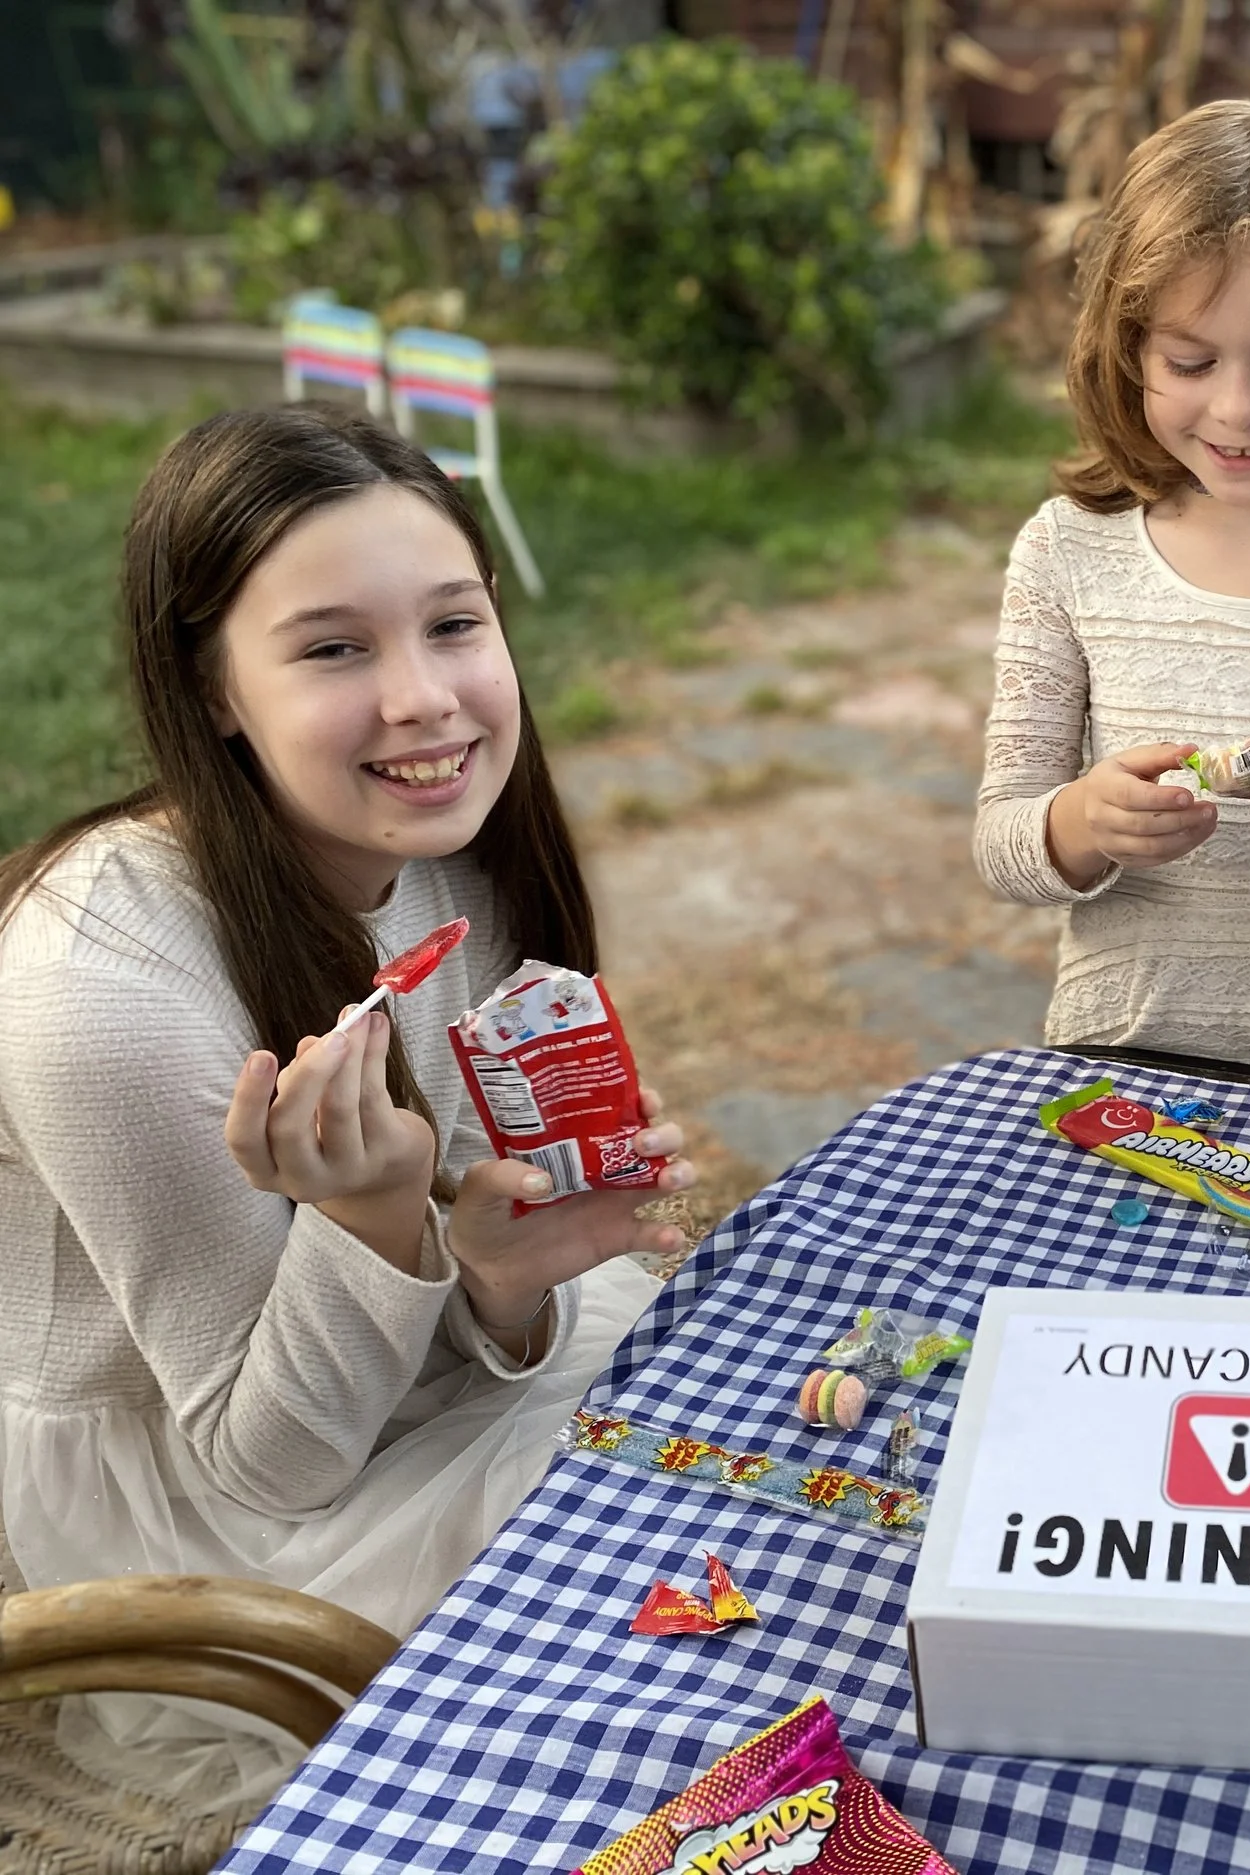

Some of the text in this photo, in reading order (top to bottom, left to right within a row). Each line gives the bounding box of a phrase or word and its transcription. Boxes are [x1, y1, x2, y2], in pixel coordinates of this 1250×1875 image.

[1170, 1162, 1245, 1189] XTREMES
[1064, 1343, 1250, 1383] CANDY
[655, 1606, 714, 1622] OPPING CANDY
[682, 1786, 837, 1875] HEADS
